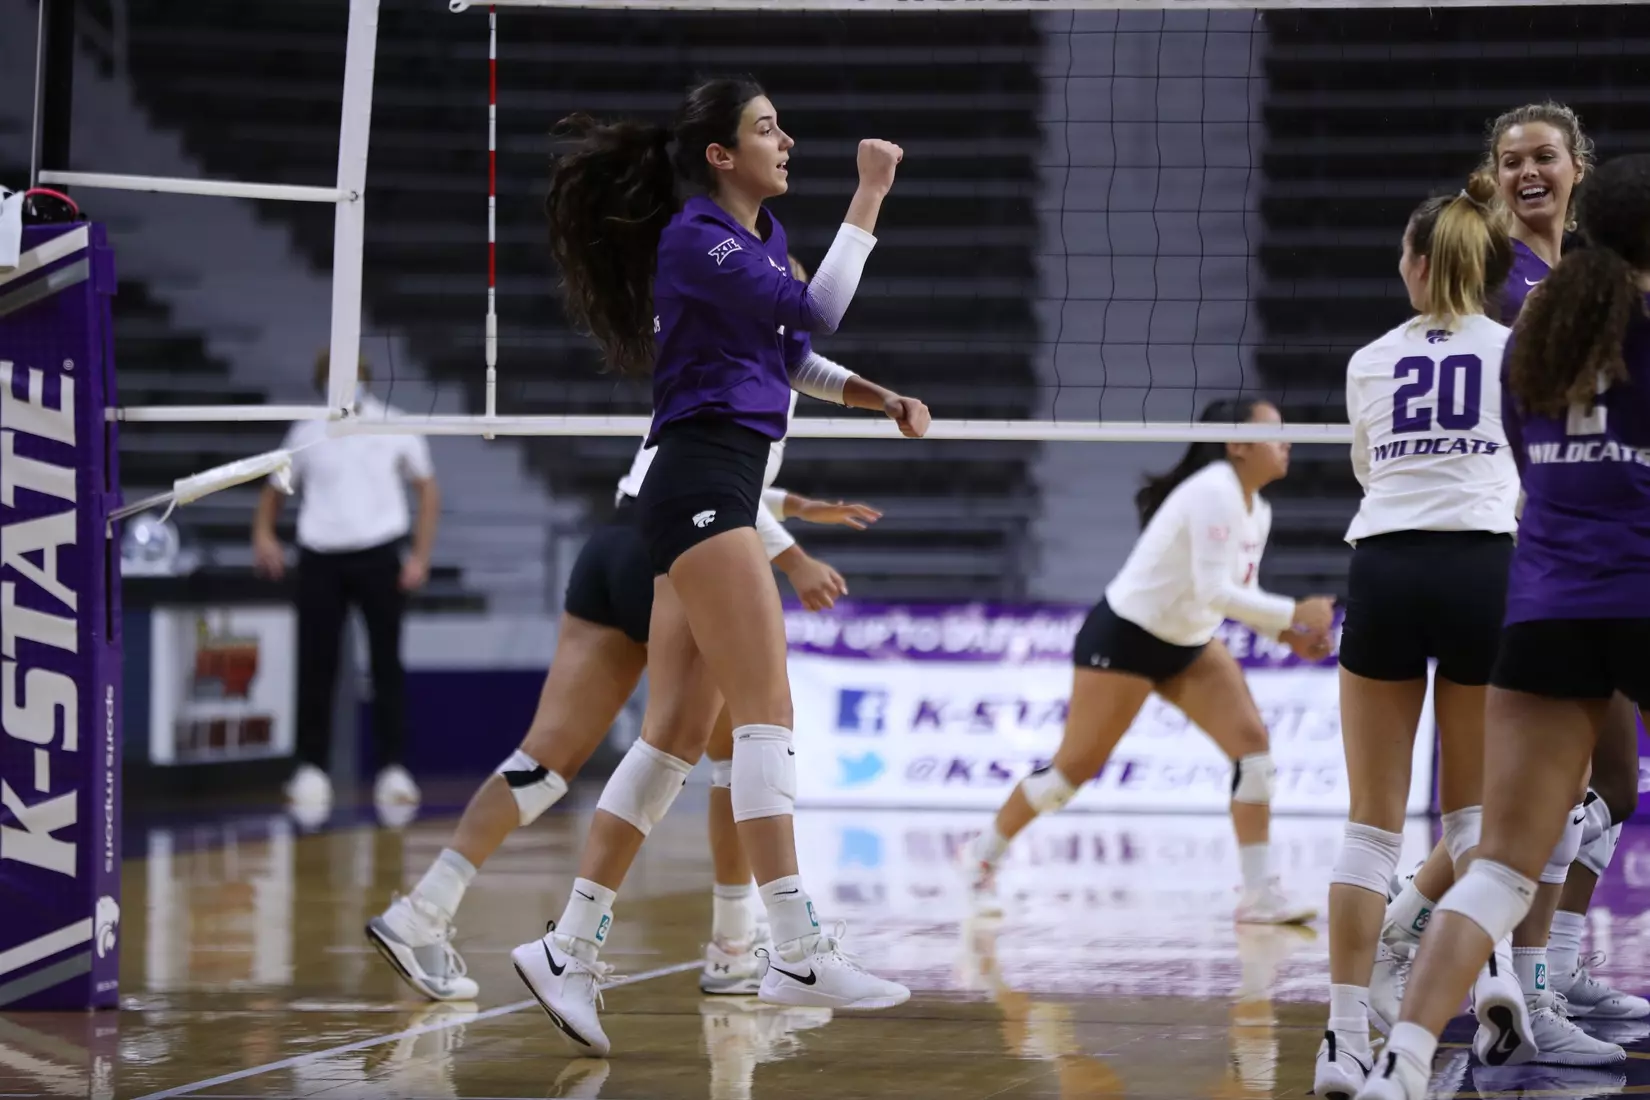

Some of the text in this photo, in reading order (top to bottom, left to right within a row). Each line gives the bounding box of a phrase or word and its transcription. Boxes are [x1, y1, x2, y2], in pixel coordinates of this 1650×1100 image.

[1374, 438, 1500, 461] WILDCATS
[1392, 354, 1482, 434] 20
[0, 360, 77, 878] K-STATE
[105, 684, 115, 873] sports imports
